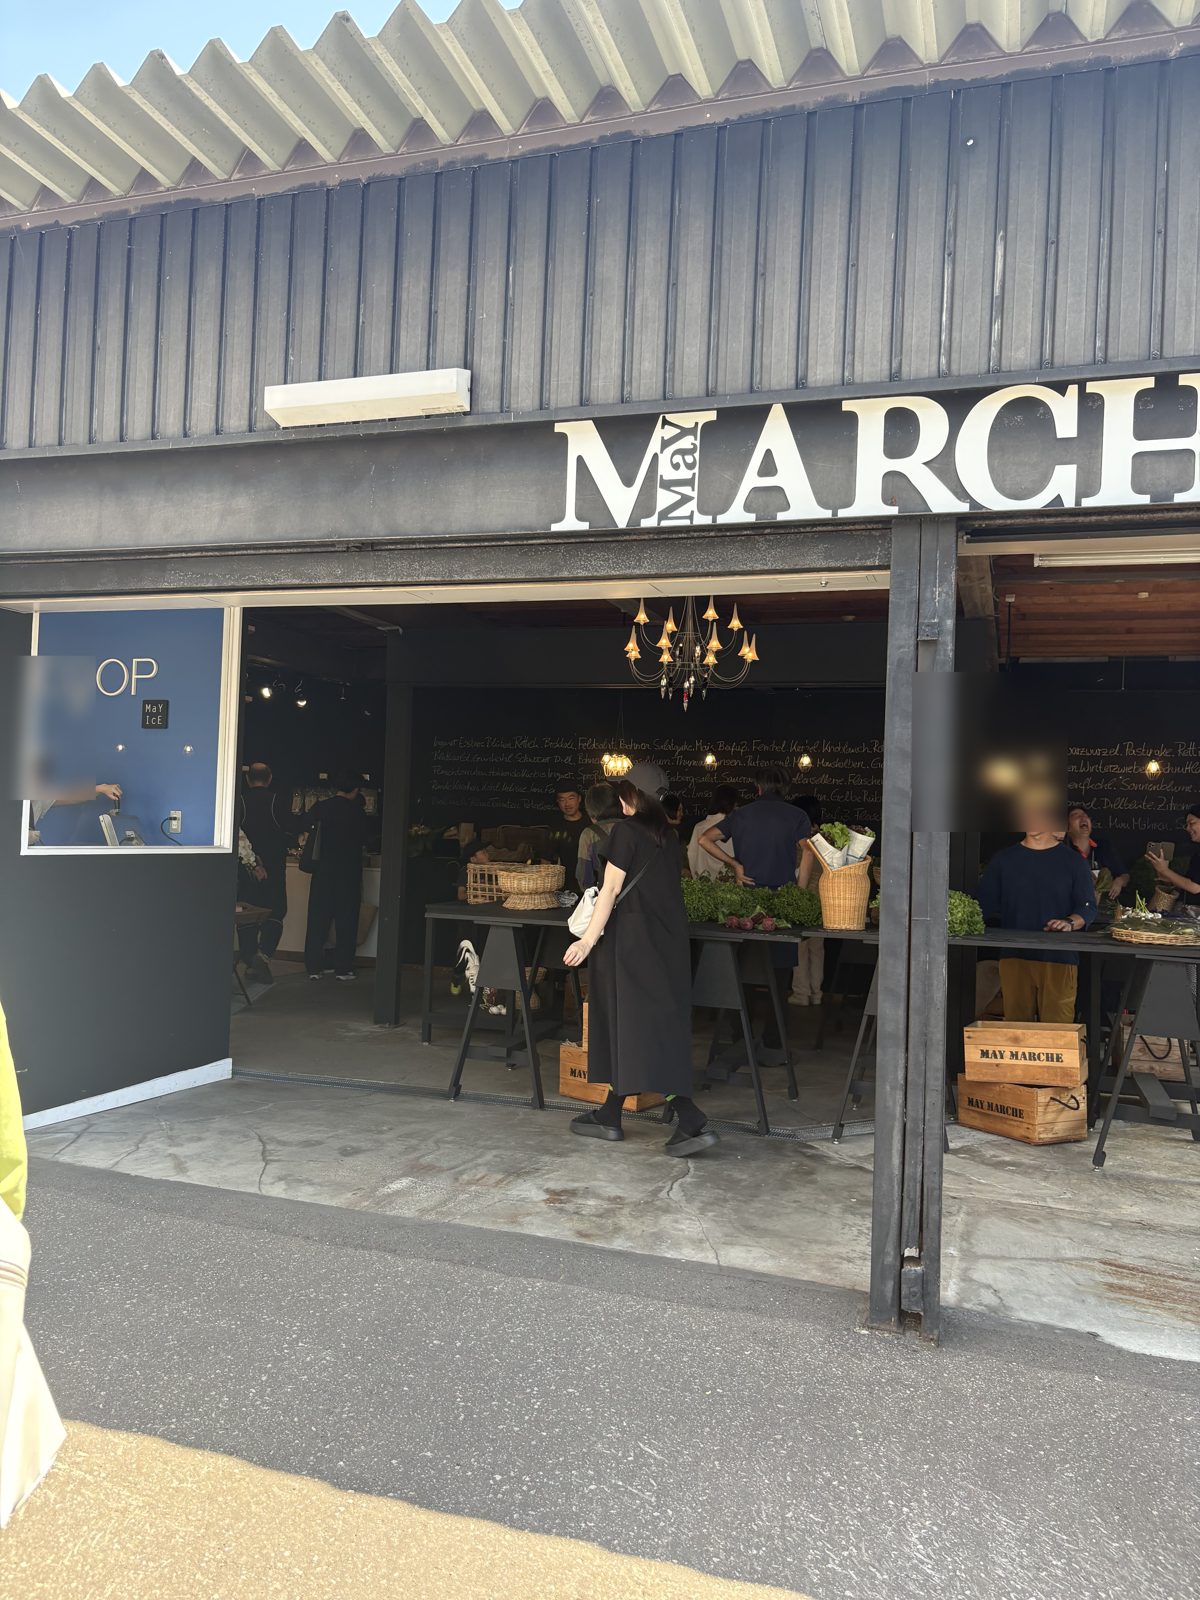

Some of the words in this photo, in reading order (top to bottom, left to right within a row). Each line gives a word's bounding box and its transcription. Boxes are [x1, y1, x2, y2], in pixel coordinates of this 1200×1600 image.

[145, 703, 164, 713] MaY
[980, 1048, 1005, 1060] MAY
[1009, 1050, 1064, 1063] MARCHE
[569, 1067, 588, 1080] MAY
[967, 1096, 985, 1109] MAY
[986, 1103, 1025, 1119] MARCHE
